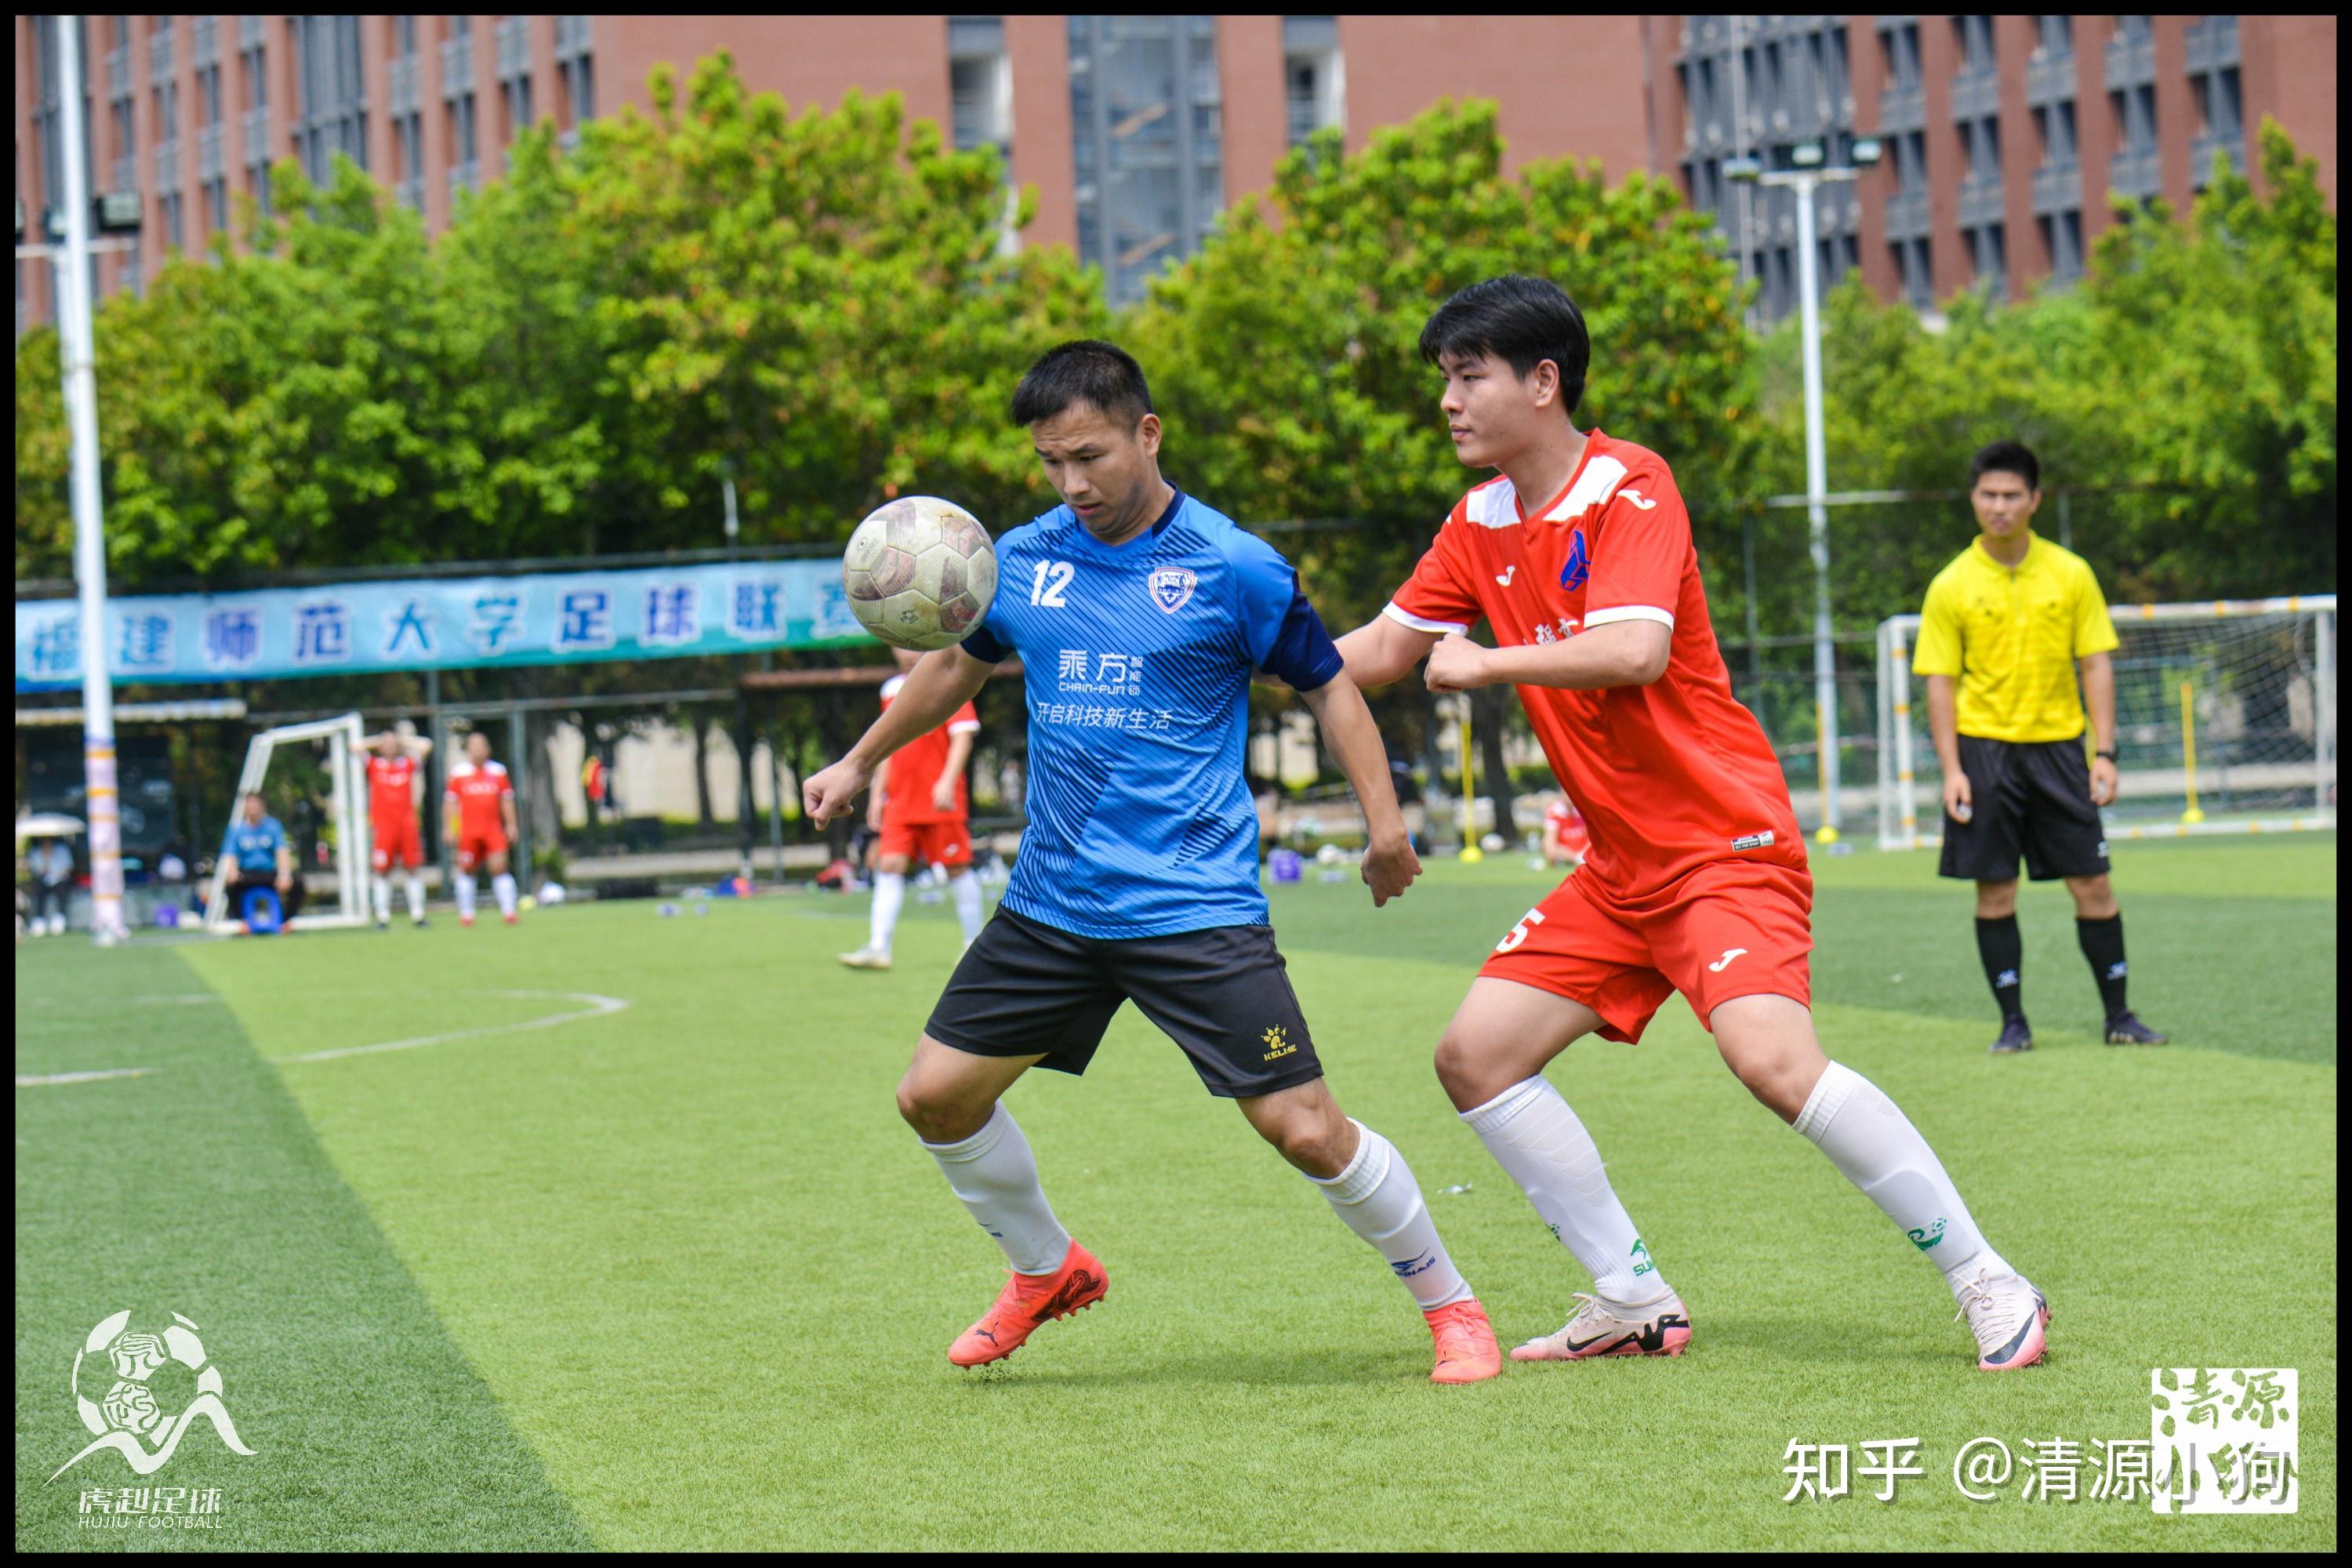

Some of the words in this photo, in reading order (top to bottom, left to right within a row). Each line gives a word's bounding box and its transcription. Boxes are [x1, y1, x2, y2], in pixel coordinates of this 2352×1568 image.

[1031, 559, 1075, 608] 12
[1058, 648, 1128, 683] 乘方
[1036, 702, 1173, 730] 开启科技新生活
[1495, 908, 1546, 953] 5
[1263, 1044, 1298, 1062] KELME
